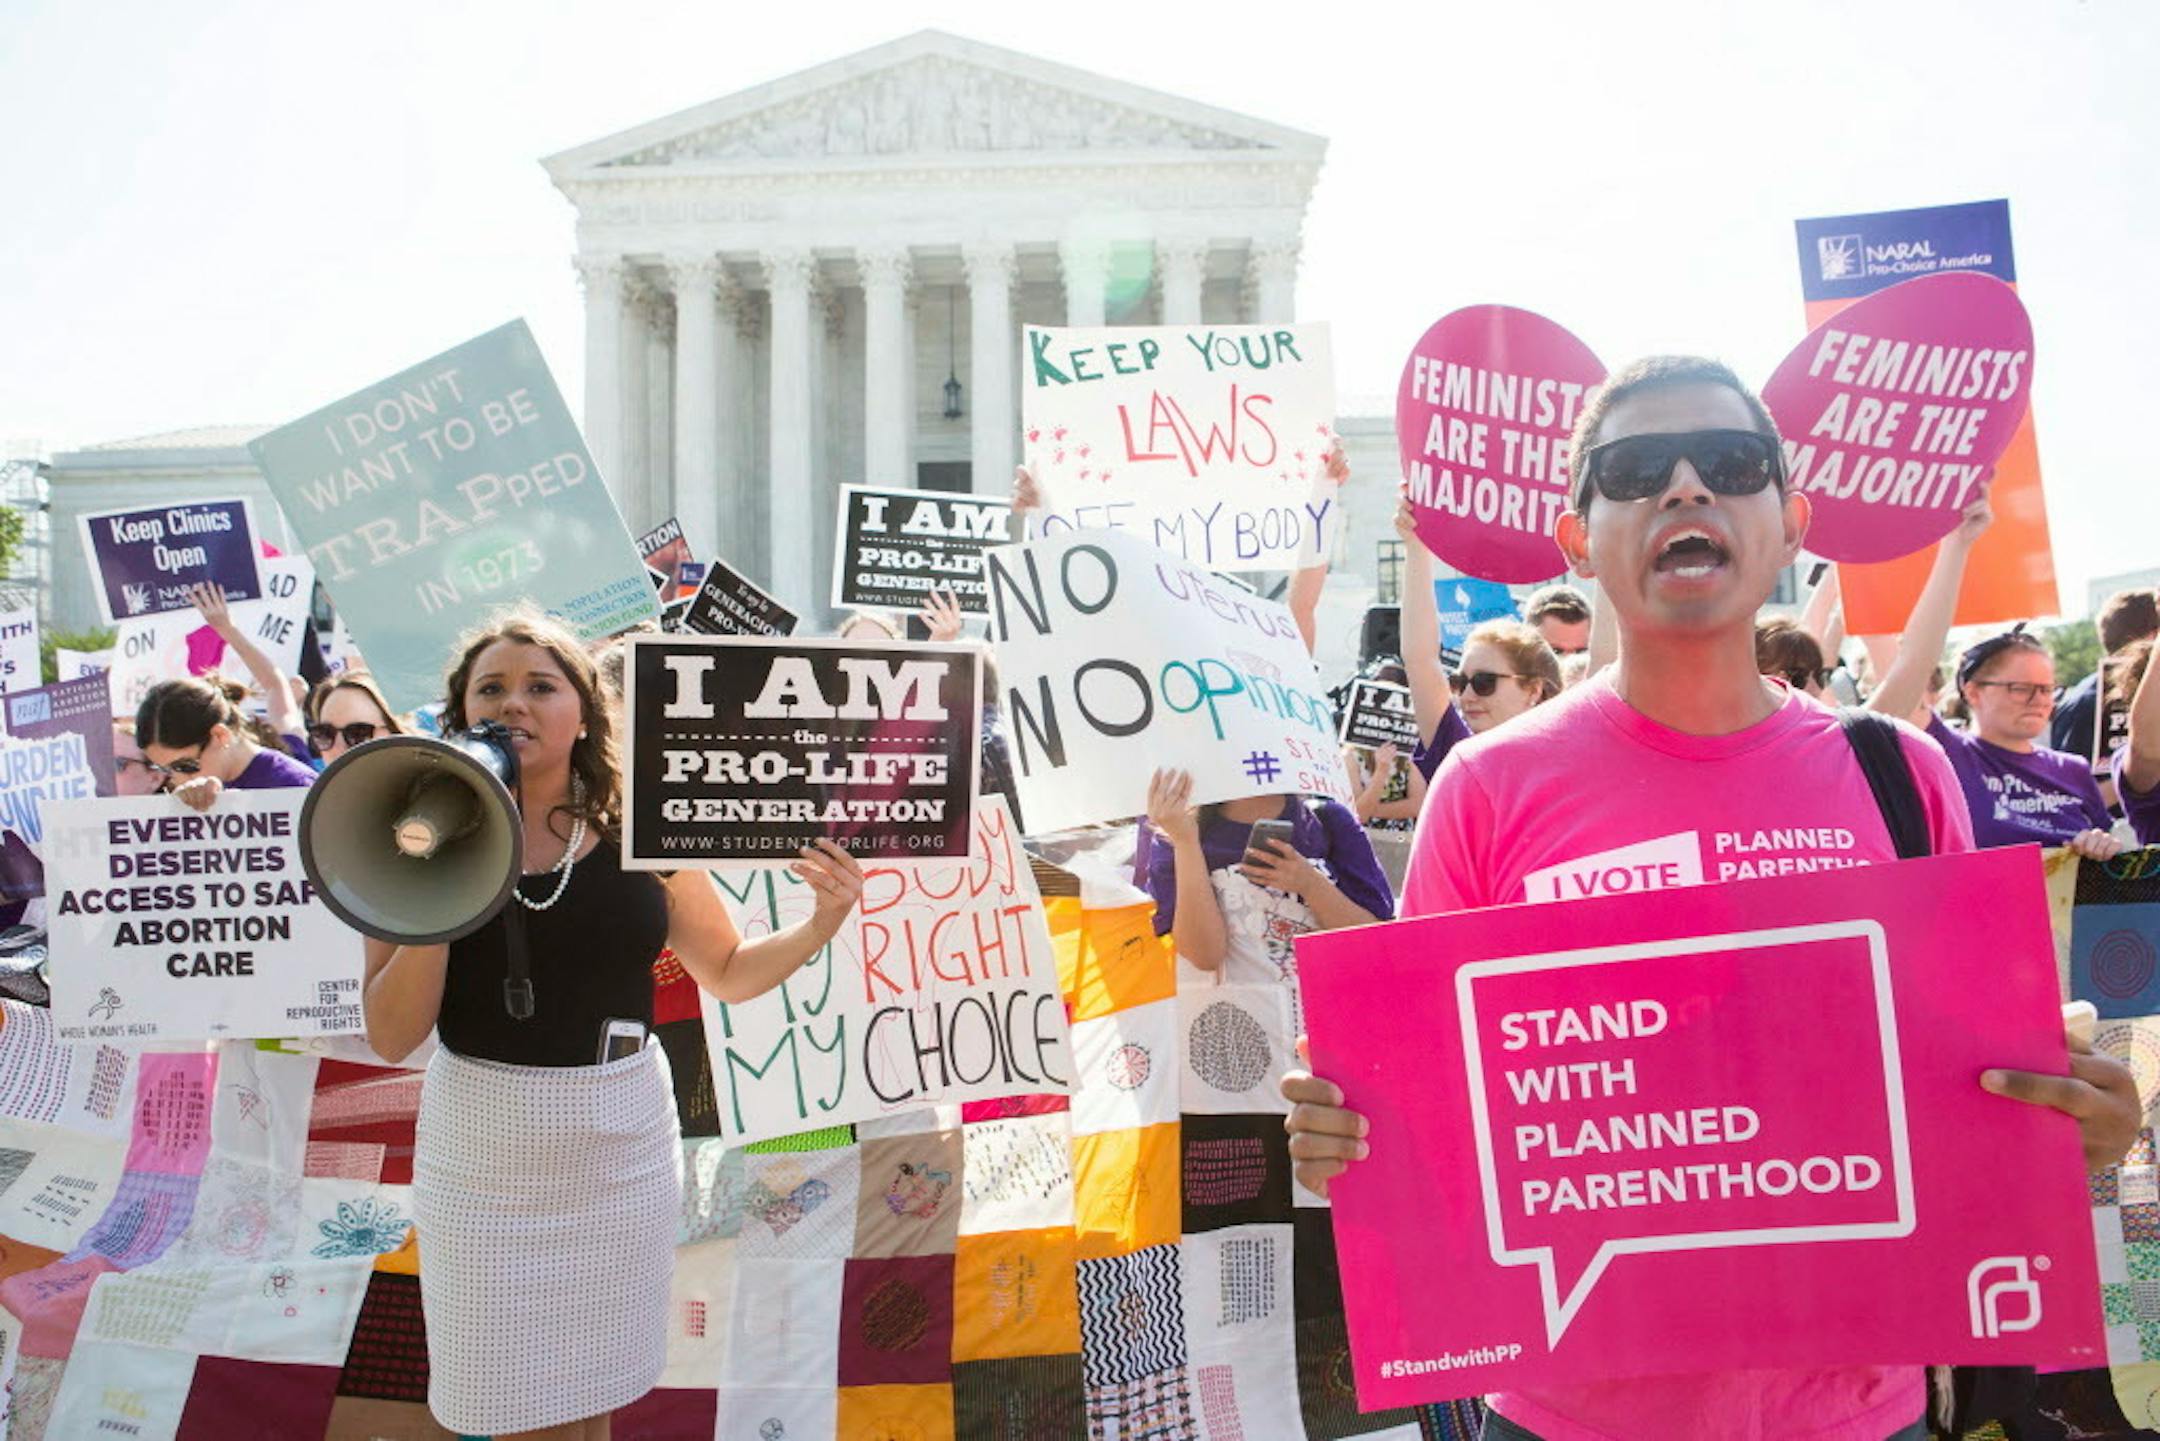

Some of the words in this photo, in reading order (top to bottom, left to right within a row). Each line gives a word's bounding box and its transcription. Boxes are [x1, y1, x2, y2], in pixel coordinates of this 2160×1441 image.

[1866, 240, 1936, 262] NARAL
[1868, 261, 1936, 275] Pro-Choice
[1939, 253, 1992, 268] America
[1029, 331, 1160, 387] KEEP
[1187, 331, 1302, 371] YOUR
[1809, 330, 2028, 402] FEMINISTS
[324, 424, 344, 456] I
[346, 369, 464, 448] DON'T
[1117, 383, 1277, 477] LAWS
[1810, 393, 1908, 449] ARE
[1910, 405, 1987, 456] THE
[302, 444, 415, 513] WANT
[420, 417, 475, 461] TO
[482, 388, 540, 437] BE
[1424, 413, 1489, 469] ARE
[1502, 428, 1571, 487] THE
[1781, 440, 1984, 511] MAJORITY
[110, 516, 164, 544] Keep
[166, 506, 232, 535] Clinics
[308, 452, 587, 581] TRAPPED
[861, 497, 889, 533] I
[901, 500, 1012, 541] AM
[1154, 502, 1223, 563] MY
[1236, 498, 1331, 560] BODY
[153, 545, 207, 575] Open
[416, 575, 463, 614] IN
[462, 539, 546, 593] 1973
[858, 547, 983, 574] PRO-LIF
[856, 573, 987, 595] GENERATIO
[989, 544, 1118, 642] NO
[124, 629, 156, 659] ON
[258, 613, 293, 646] ME
[663, 655, 716, 719] I
[743, 656, 949, 721] AM
[1010, 658, 1154, 777] NO
[793, 729, 829, 745] the
[662, 749, 949, 785] PRO-LIFE
[108, 812, 291, 845] EVERYONE
[661, 798, 947, 823] GENERATION
[1716, 828, 1856, 854] PLANNED
[109, 846, 285, 878] DESERVES
[1573, 862, 1680, 897] VOTE
[58, 884, 196, 916] ACCESS
[205, 884, 246, 908] TO
[255, 880, 318, 906] SAF
[113, 916, 291, 948] ABORTION
[167, 952, 255, 978] CARE
[860, 904, 1032, 1004] RIGHT
[318, 979, 359, 993] CENTER
[320, 992, 339, 1005] FOR
[286, 1004, 361, 1020] REPRODUCTIVE
[321, 1017, 361, 1030] RIGHTS
[1500, 999, 1668, 1051] STAND
[863, 989, 1068, 1104] CHOICE
[1506, 1058, 1637, 1105] WITH
[1515, 1106, 1761, 1162] PLANNED
[1521, 1154, 1882, 1217] PARENTHOOD
[1380, 1341, 1523, 1379] #StandwithPP
